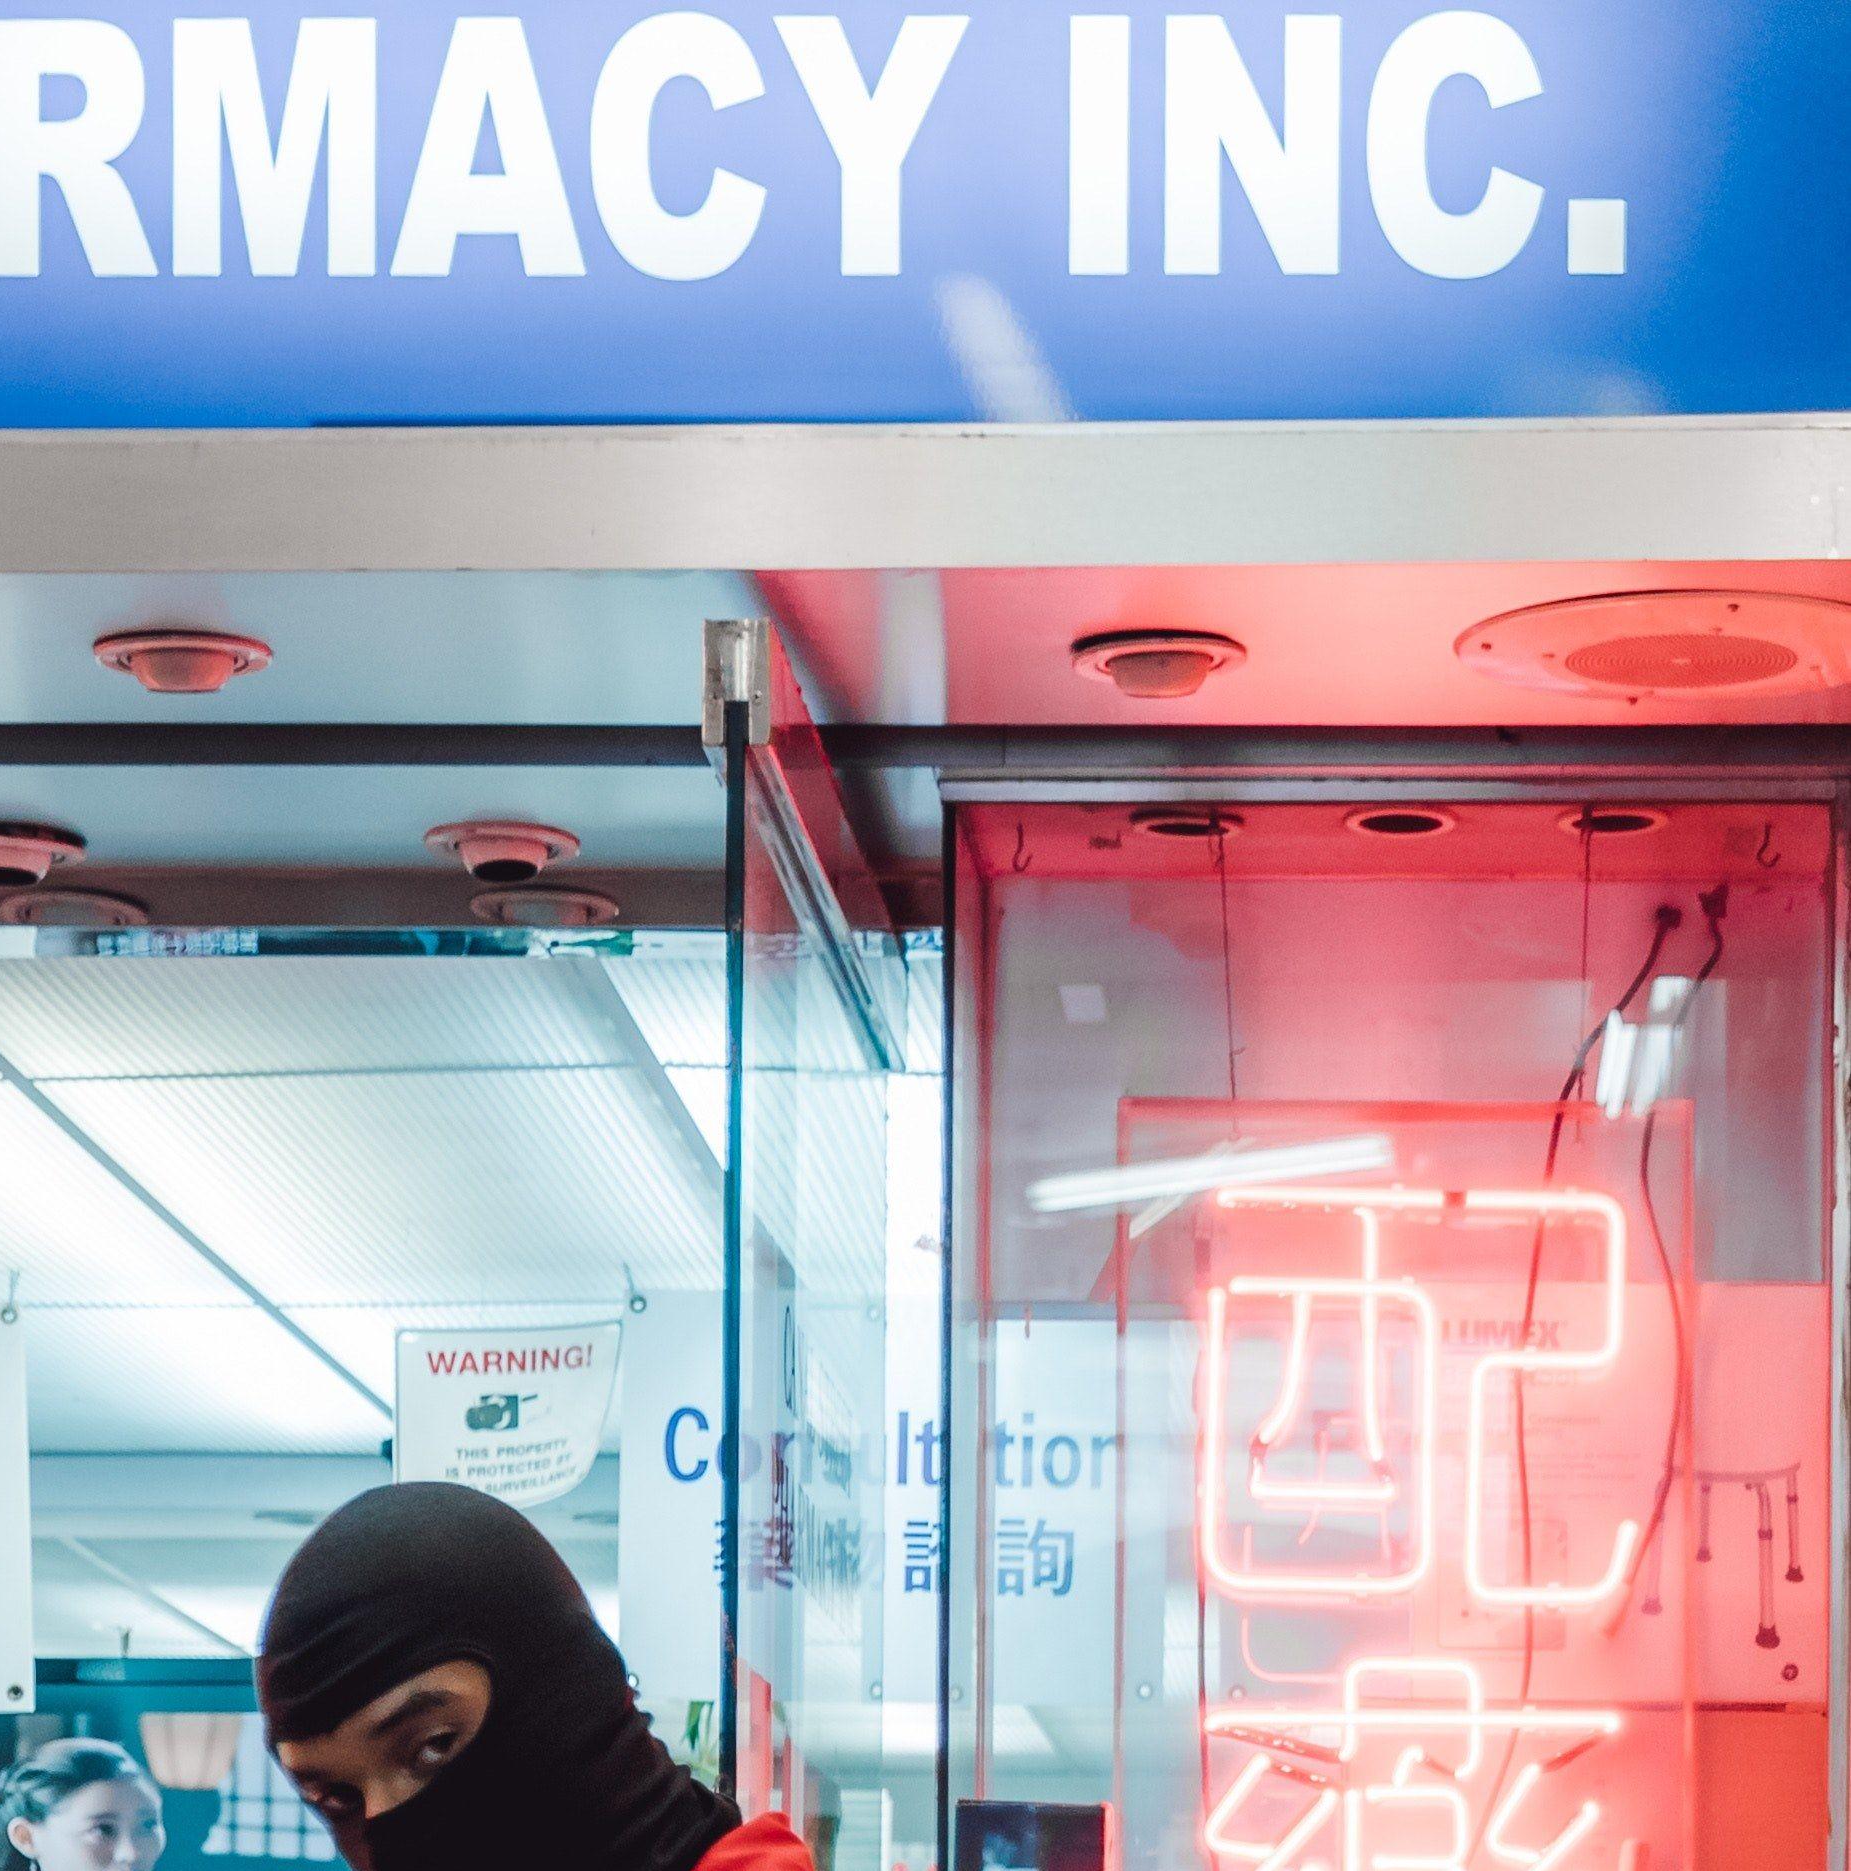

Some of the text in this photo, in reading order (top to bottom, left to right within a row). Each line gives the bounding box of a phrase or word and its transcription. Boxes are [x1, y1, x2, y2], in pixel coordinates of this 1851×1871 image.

[1066, 6, 1625, 280] INC.
[1442, 1319, 1560, 1349] LUMEX
[427, 1344, 593, 1376] WARNING!
[456, 1438, 568, 1461] THIS PROPERTY
[466, 1460, 551, 1478] PROTECTED
